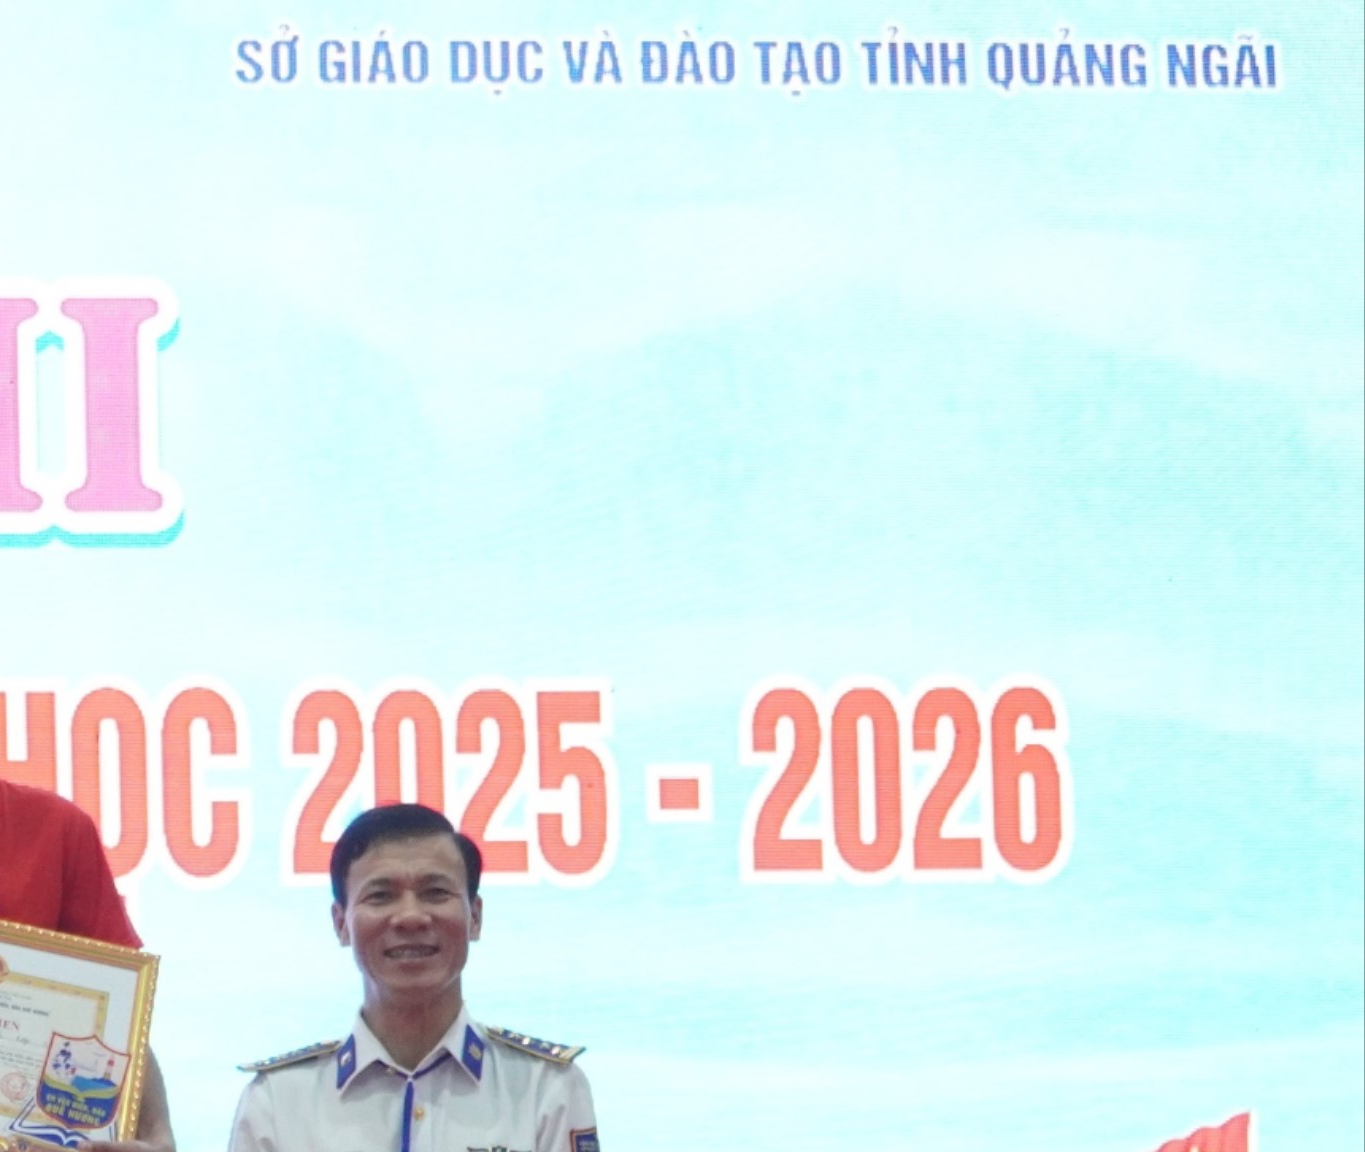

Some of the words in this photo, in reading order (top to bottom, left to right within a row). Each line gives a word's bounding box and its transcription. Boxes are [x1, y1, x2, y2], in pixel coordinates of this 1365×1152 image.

[235, 23, 299, 85] SỞ
[318, 29, 429, 84] GIÁO
[450, 41, 544, 95] DỤC
[562, 28, 623, 84] VÀ
[640, 28, 736, 85] ĐÀO
[754, 40, 841, 96] TẠO
[860, 24, 967, 86] TỈNH
[986, 25, 1149, 91] QUẢNG
[1167, 33, 1277, 89] NGÃI
[290, 686, 606, 877] 2025
[752, 684, 1064, 877] 2026
